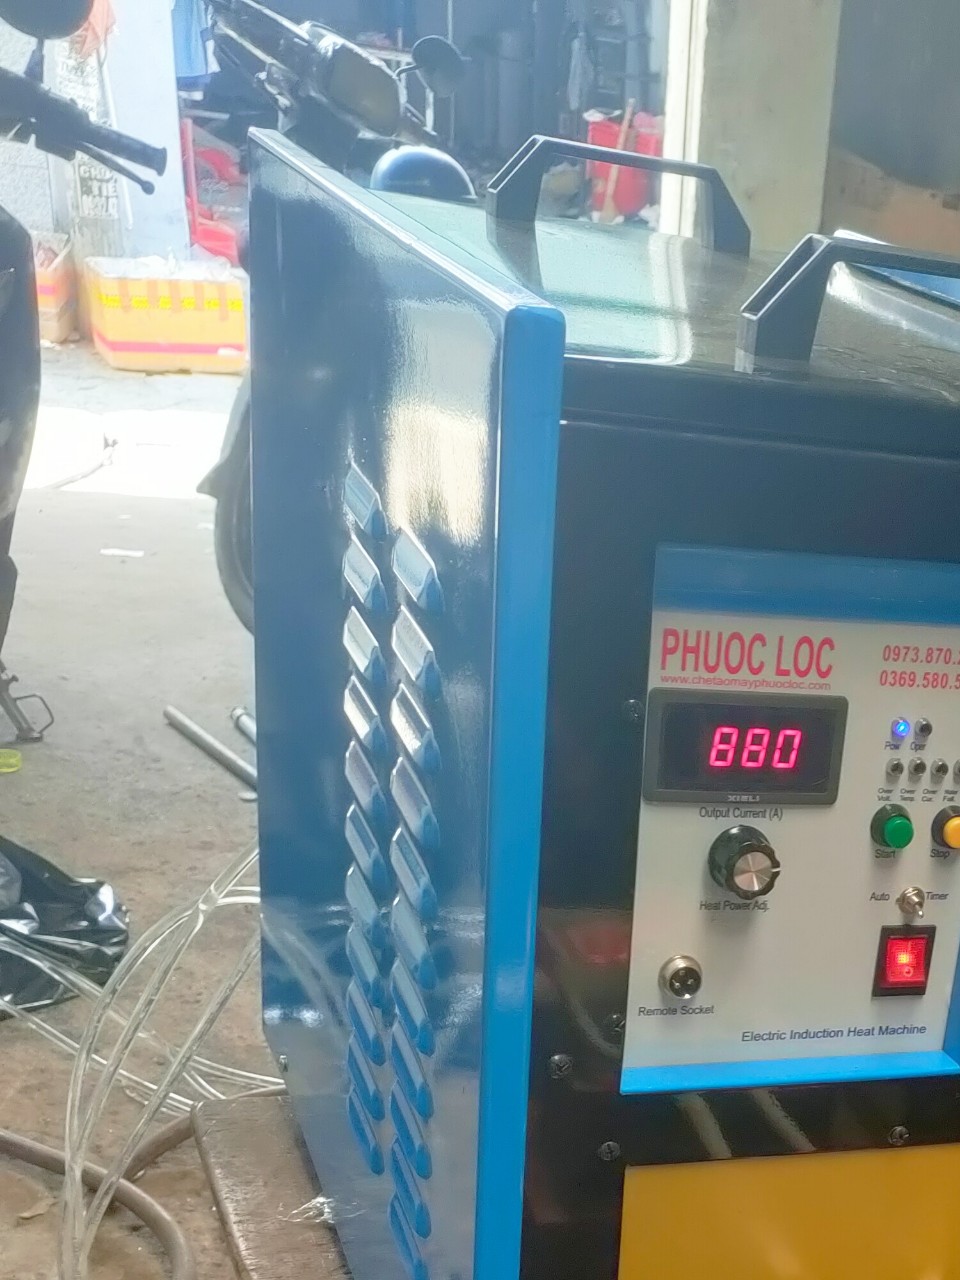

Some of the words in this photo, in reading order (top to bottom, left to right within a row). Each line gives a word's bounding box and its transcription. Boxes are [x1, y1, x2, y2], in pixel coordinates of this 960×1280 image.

[660, 627, 767, 676] PHUOC
[775, 635, 835, 679] LOC
[660, 675, 832, 690] www.chetaomayphuocloc.com
[708, 725, 803, 769] 880
[699, 806, 731, 820] Output
[732, 806, 767, 819] Current
[769, 807, 783, 821] (A)
[874, 848, 896, 859] Start
[929, 848, 951, 860] Stop
[869, 891, 891, 901] Auto
[925, 891, 949, 901] Timer
[699, 900, 722, 911] Heat
[722, 900, 751, 911] Power
[638, 1005, 678, 1017] Remote
[680, 1004, 714, 1015] Socket
[741, 1029, 787, 1042] Electric
[789, 1027, 844, 1041] Induction
[846, 1025, 875, 1038] Heat
[877, 1023, 928, 1037] Machine
